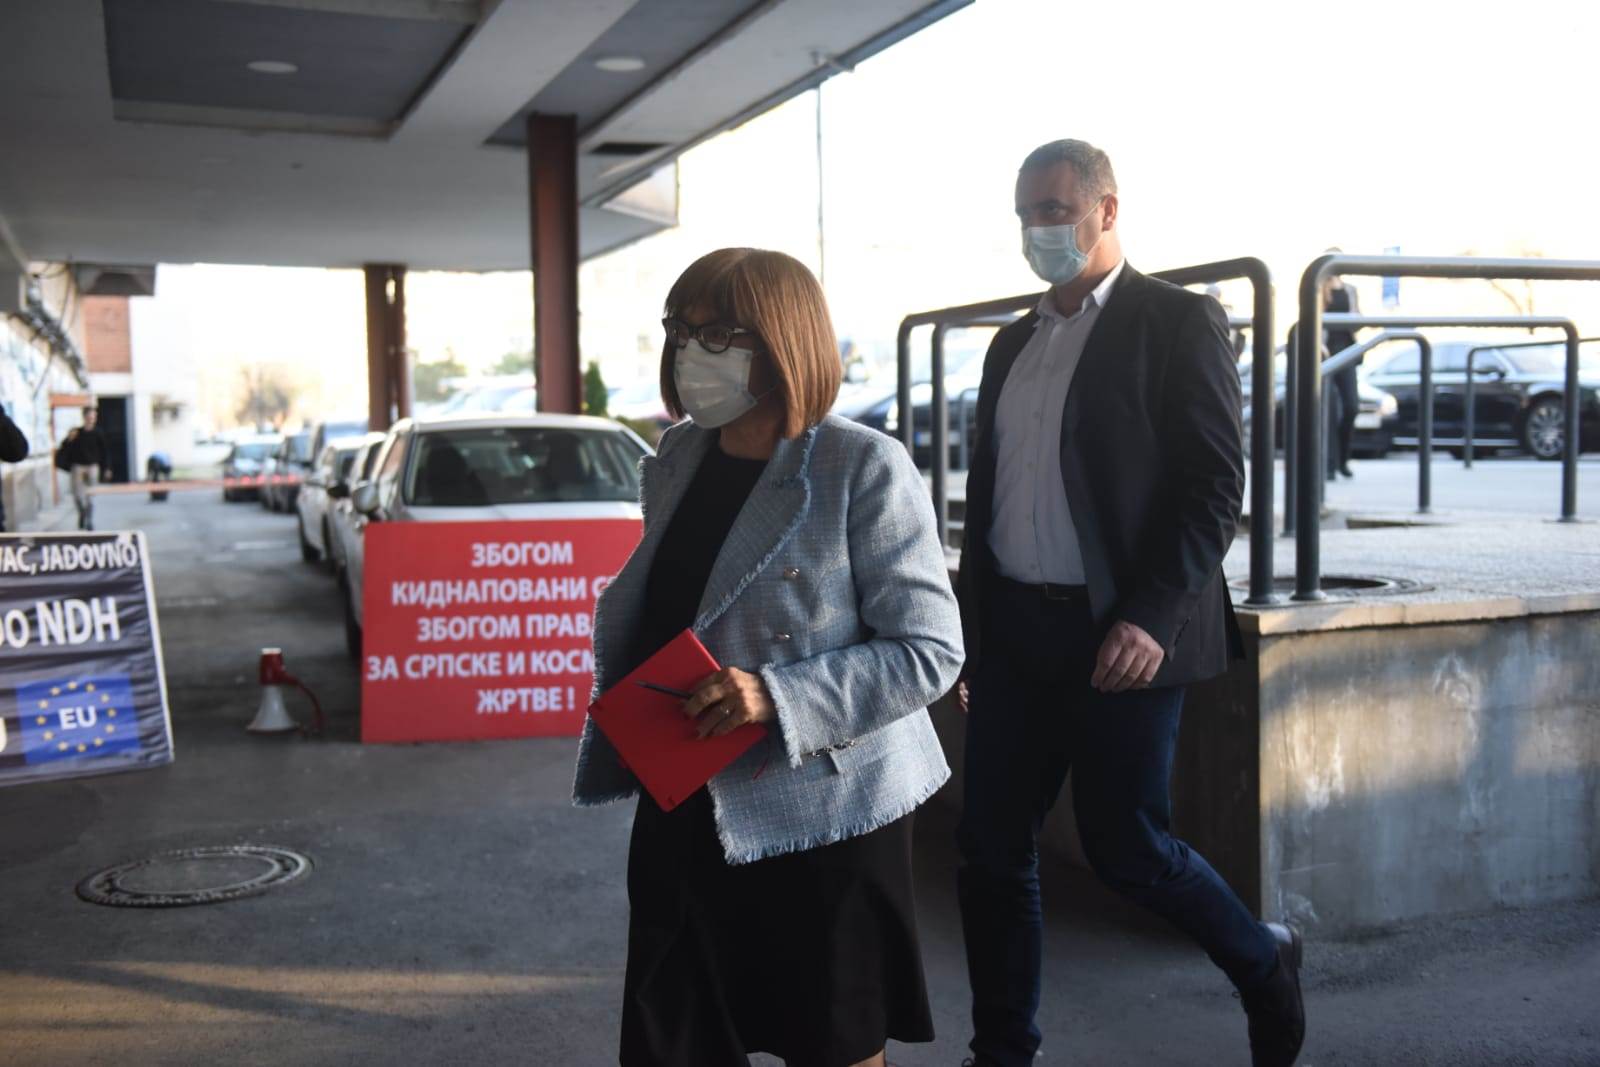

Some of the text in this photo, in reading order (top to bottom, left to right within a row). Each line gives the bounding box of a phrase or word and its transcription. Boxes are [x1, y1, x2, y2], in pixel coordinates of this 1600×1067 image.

[0, 542, 138, 575] AC, JADOVNO
[471, 542, 573, 567] ЗБОГОМ
[391, 575, 617, 608] КИДНАПОВАНИ С
[0, 597, 120, 648] O NDH
[417, 612, 593, 642] ЗБОГОМ ПРАВ
[367, 656, 399, 680] ЗА
[405, 652, 501, 678] СРПСКЕ
[507, 651, 526, 674] И
[477, 688, 563, 713] ЖРТВЕ
[58, 705, 97, 730] EU
